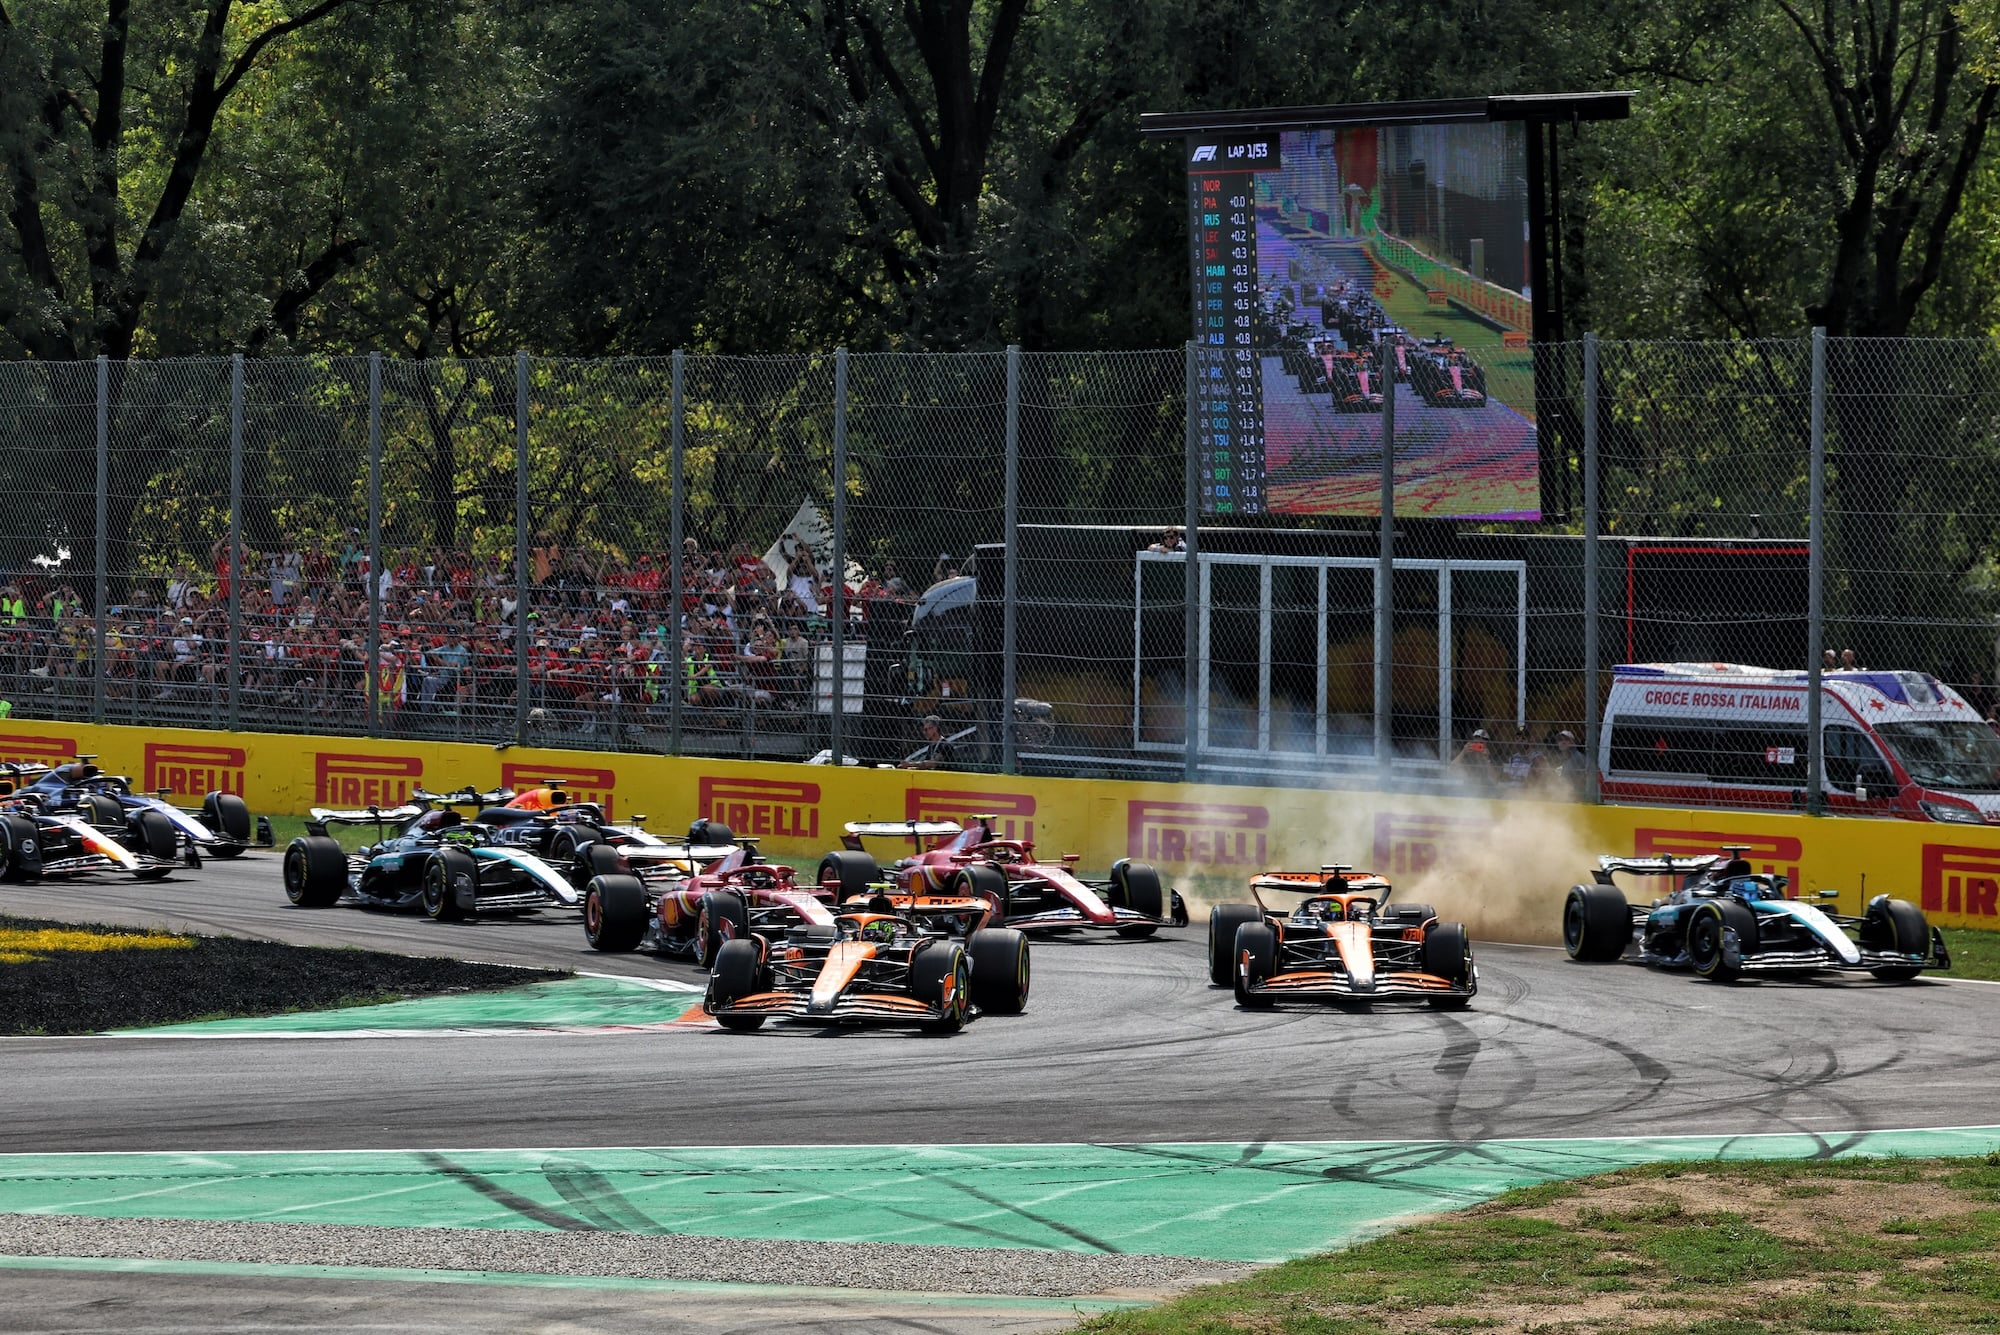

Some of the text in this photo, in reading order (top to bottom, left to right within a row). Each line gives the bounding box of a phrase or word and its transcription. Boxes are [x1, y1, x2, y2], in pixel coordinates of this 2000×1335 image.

[1228, 143, 1267, 159] LAP 1/53
[1203, 180, 1220, 191] NOR
[1204, 197, 1217, 208] PIA
[1230, 196, 1245, 207] +0.0
[1204, 214, 1220, 226] RUS
[1230, 213, 1245, 224] +0.1
[1206, 232, 1218, 243] LEC
[1231, 231, 1246, 241] +0.2
[1206, 248, 1217, 259] SAI
[1232, 247, 1247, 258] +0.3
[1206, 265, 1225, 276] HAM
[1232, 264, 1247, 276] +0.3
[1207, 282, 1222, 294] VER
[1233, 281, 1248, 292] +0.5
[1208, 299, 1222, 310] PER
[1234, 299, 1248, 310] +0.5
[1209, 316, 1223, 327] ALO
[1234, 316, 1249, 327] +0.8
[1209, 333, 1224, 344] ALB
[1235, 333, 1250, 344] +0.8
[1236, 350, 1251, 361] +0.9
[1211, 367, 1223, 378] RIC
[1237, 367, 1251, 378] +0.9
[1238, 384, 1252, 395] +1.1
[1212, 401, 1228, 412] GAS
[1239, 418, 1254, 429] +1.3
[1214, 435, 1229, 446] TSU
[1240, 435, 1254, 446] +1.4
[1215, 452, 1229, 462] STR
[1241, 452, 1255, 463] +1.5
[1215, 469, 1230, 480] BOT
[1242, 469, 1256, 480] +1.7
[1216, 485, 1230, 496] COL
[1645, 691, 1800, 710] CROCE ROSSA ITALIANA
[144, 743, 246, 799] PIRELLI
[316, 752, 423, 807] PIRELL
[698, 776, 821, 838] PIRELLI
[1127, 800, 1269, 866] PIRELLI
